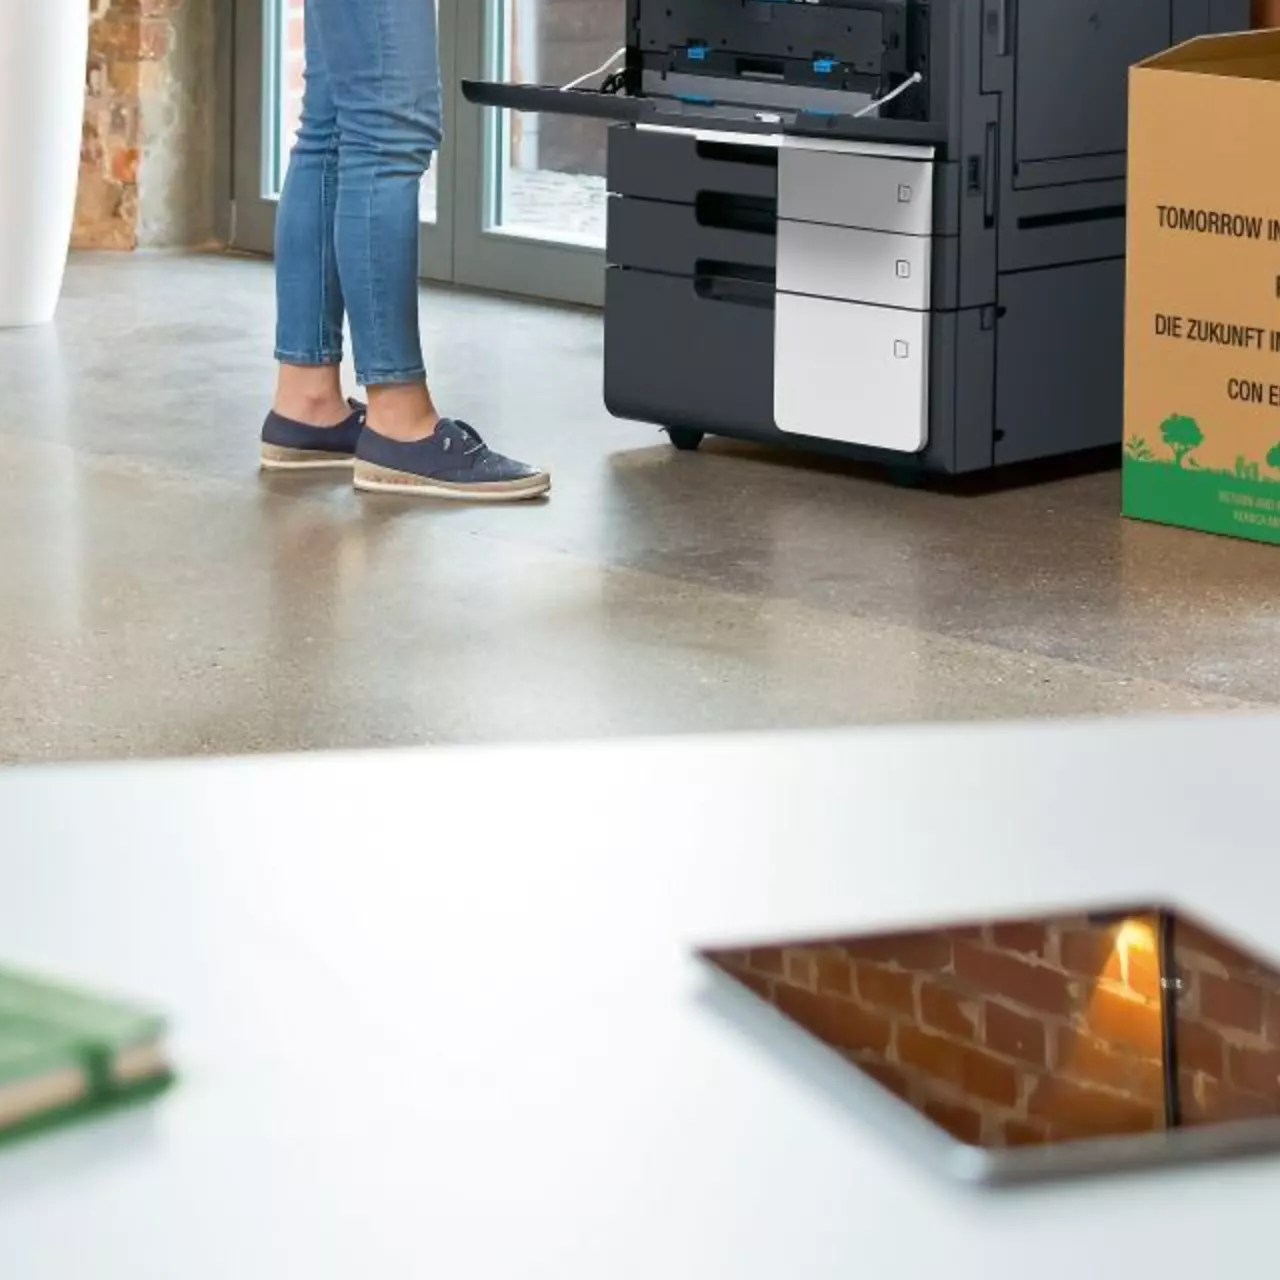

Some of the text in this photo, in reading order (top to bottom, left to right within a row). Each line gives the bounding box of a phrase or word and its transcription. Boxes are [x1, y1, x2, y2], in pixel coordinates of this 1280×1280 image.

[1156, 205, 1263, 240] TOMORROW
[1155, 314, 1183, 338] DIE
[1186, 319, 1265, 350] ZUKUNFT
[1227, 378, 1263, 403] CON
